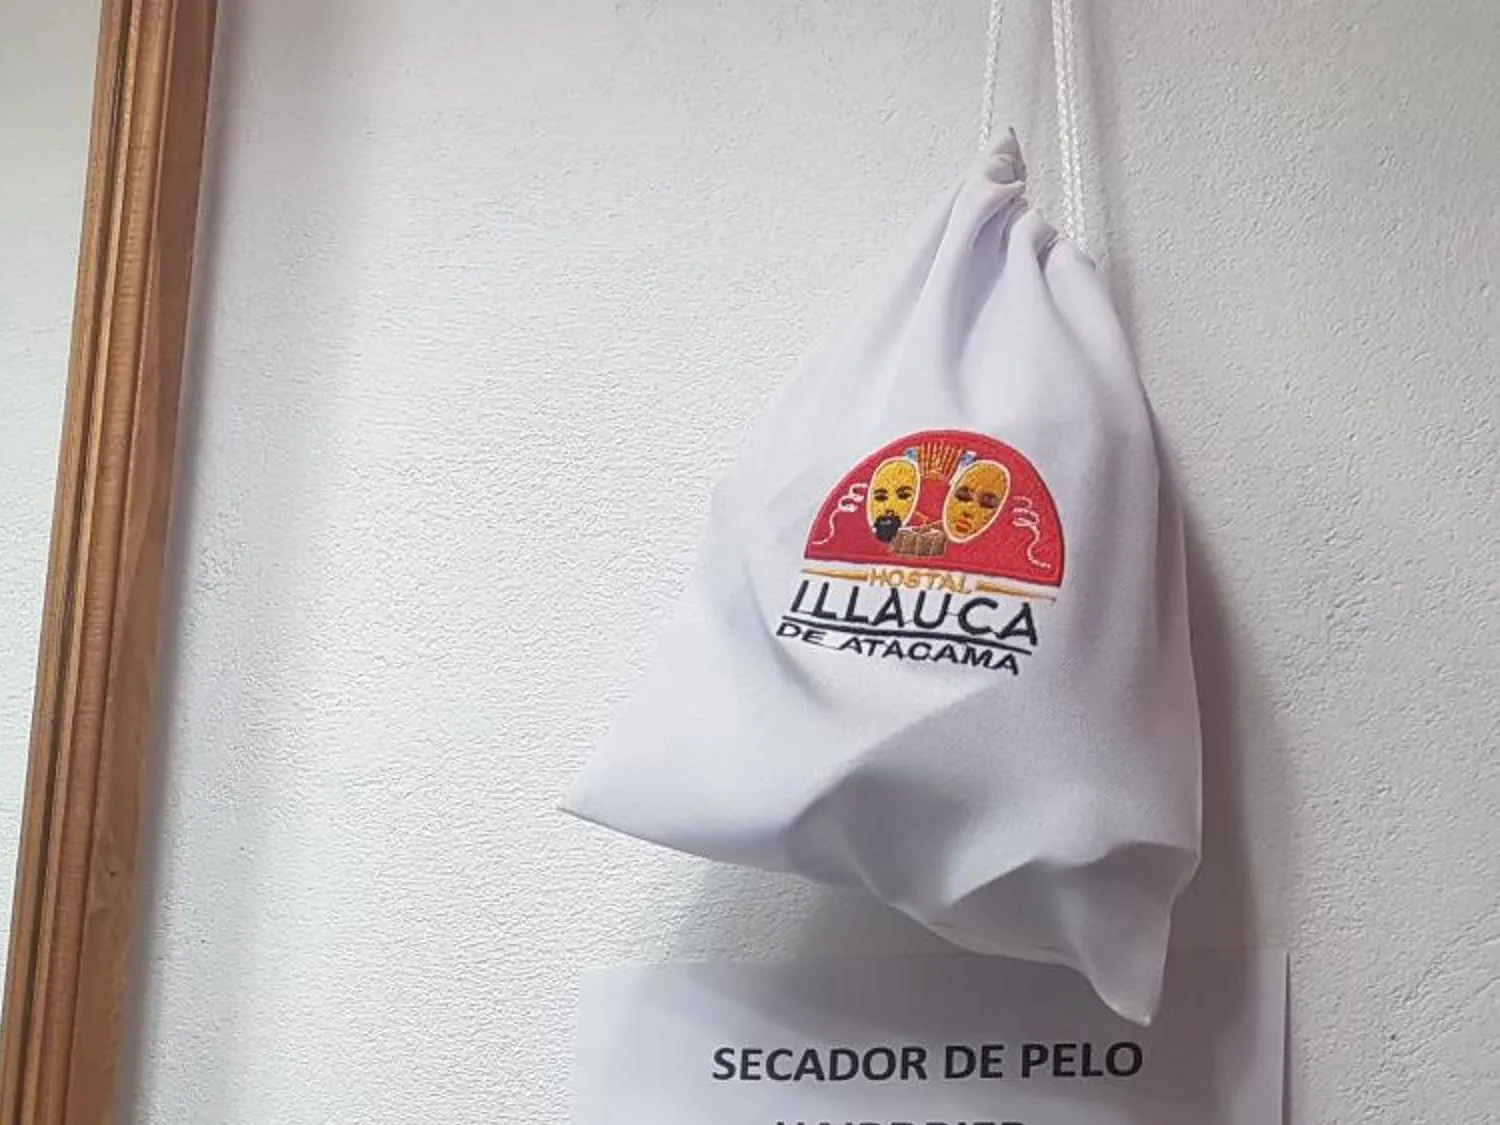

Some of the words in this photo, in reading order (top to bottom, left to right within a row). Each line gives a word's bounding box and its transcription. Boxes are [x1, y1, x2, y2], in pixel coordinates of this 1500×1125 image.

[868, 568, 972, 594] HOSTAL
[790, 580, 1038, 646] ILLAUCA
[776, 622, 825, 645] DE
[840, 636, 1019, 676] ATACAMA
[711, 1046, 928, 1082] SECADOR
[943, 1044, 1004, 1079] DE
[1020, 1041, 1143, 1078] PELO
